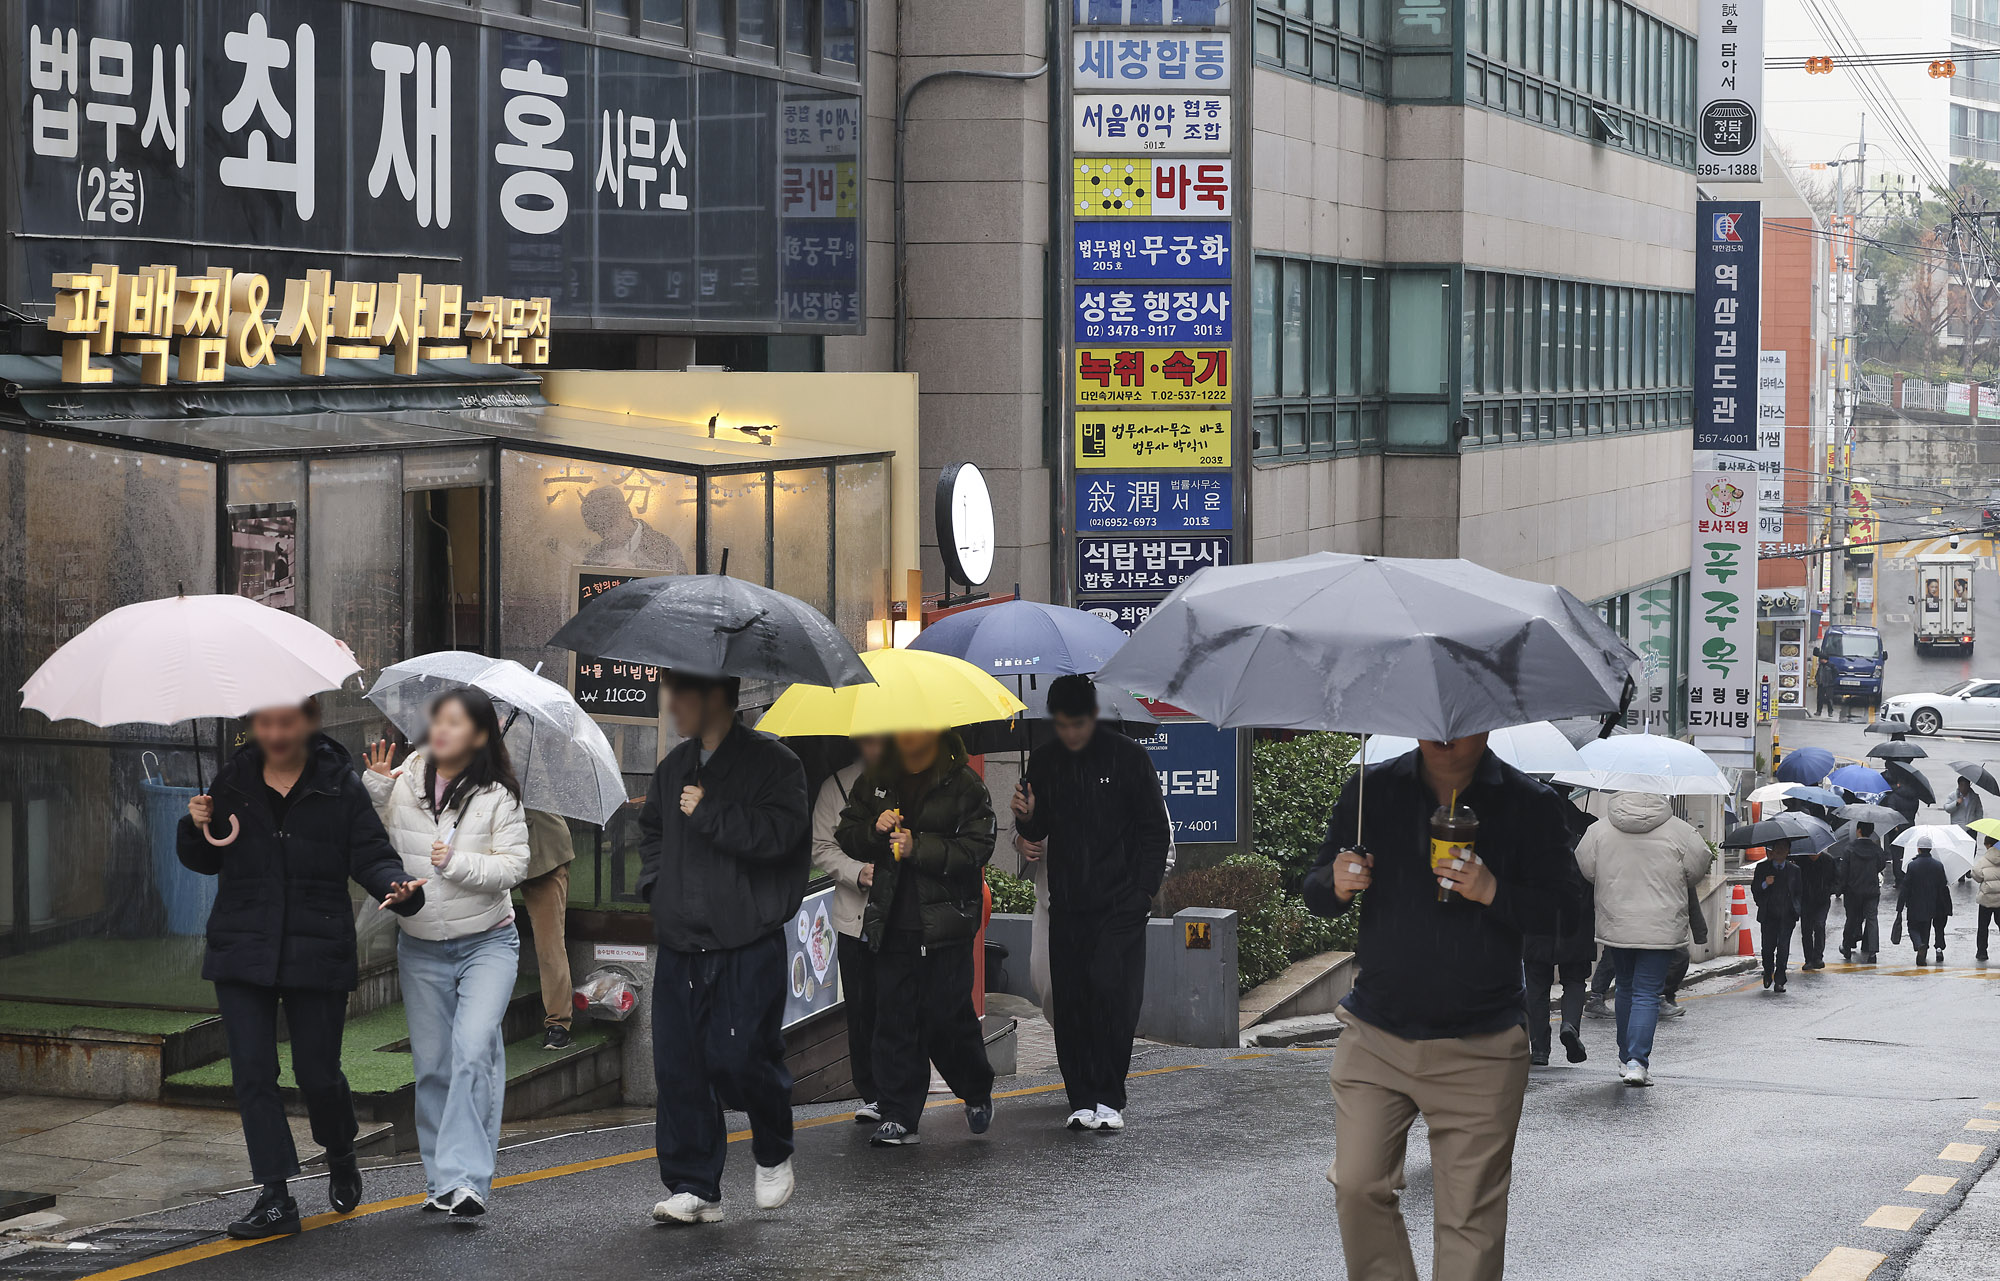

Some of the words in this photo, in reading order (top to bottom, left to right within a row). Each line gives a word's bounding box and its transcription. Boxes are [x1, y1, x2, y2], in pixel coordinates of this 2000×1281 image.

[1079, 39, 1224, 80] 세창합동
[1721, 43, 1737, 90] 담아서
[30, 24, 190, 168] 법무사
[595, 108, 689, 211] 사무소
[1183, 100, 1222, 118] 협동
[1082, 103, 1175, 138] 서울생약
[1714, 119, 1743, 132] 정담
[1183, 123, 1222, 141] 조합
[1714, 132, 1742, 145] 한식
[1143, 141, 1166, 150] 501호
[1697, 164, 1758, 176] 595-1388
[77, 165, 145, 226] (2층)
[1156, 164, 1229, 211] 바둑
[1078, 239, 1137, 259] 법무법인
[1139, 234, 1229, 266] 무궁화
[1092, 261, 1123, 271] 205호
[1079, 290, 1137, 322] 성훈
[1142, 290, 1230, 322] 행정사
[464, 296, 552, 364] 전문점
[1086, 325, 1104, 337] 02)
[1107, 324, 1177, 337] 3478-9117
[1193, 324, 1223, 337] 301호
[1712, 264, 1740, 424] 역삼검도관
[1081, 391, 1142, 401] 다인속기사무소
[1111, 423, 1192, 440] 법무사사무소
[1199, 422, 1225, 434] 바로
[1698, 434, 1749, 443] 567·4001
[1132, 441, 1169, 456] 법무사
[1199, 455, 1224, 465] 203호
[1170, 479, 1221, 490] 법률사무소
[1089, 517, 1157, 527] (02)6952-6973
[1183, 516, 1211, 527] 201호
[1698, 520, 1749, 533] 본사직영
[1118, 572, 1164, 588] 사무소
[1701, 542, 1742, 680] 푸주옥
[580, 664, 603, 679] 나물
[613, 666, 658, 682] 비빔밥
[1689, 710, 1750, 729] 도가니탕
